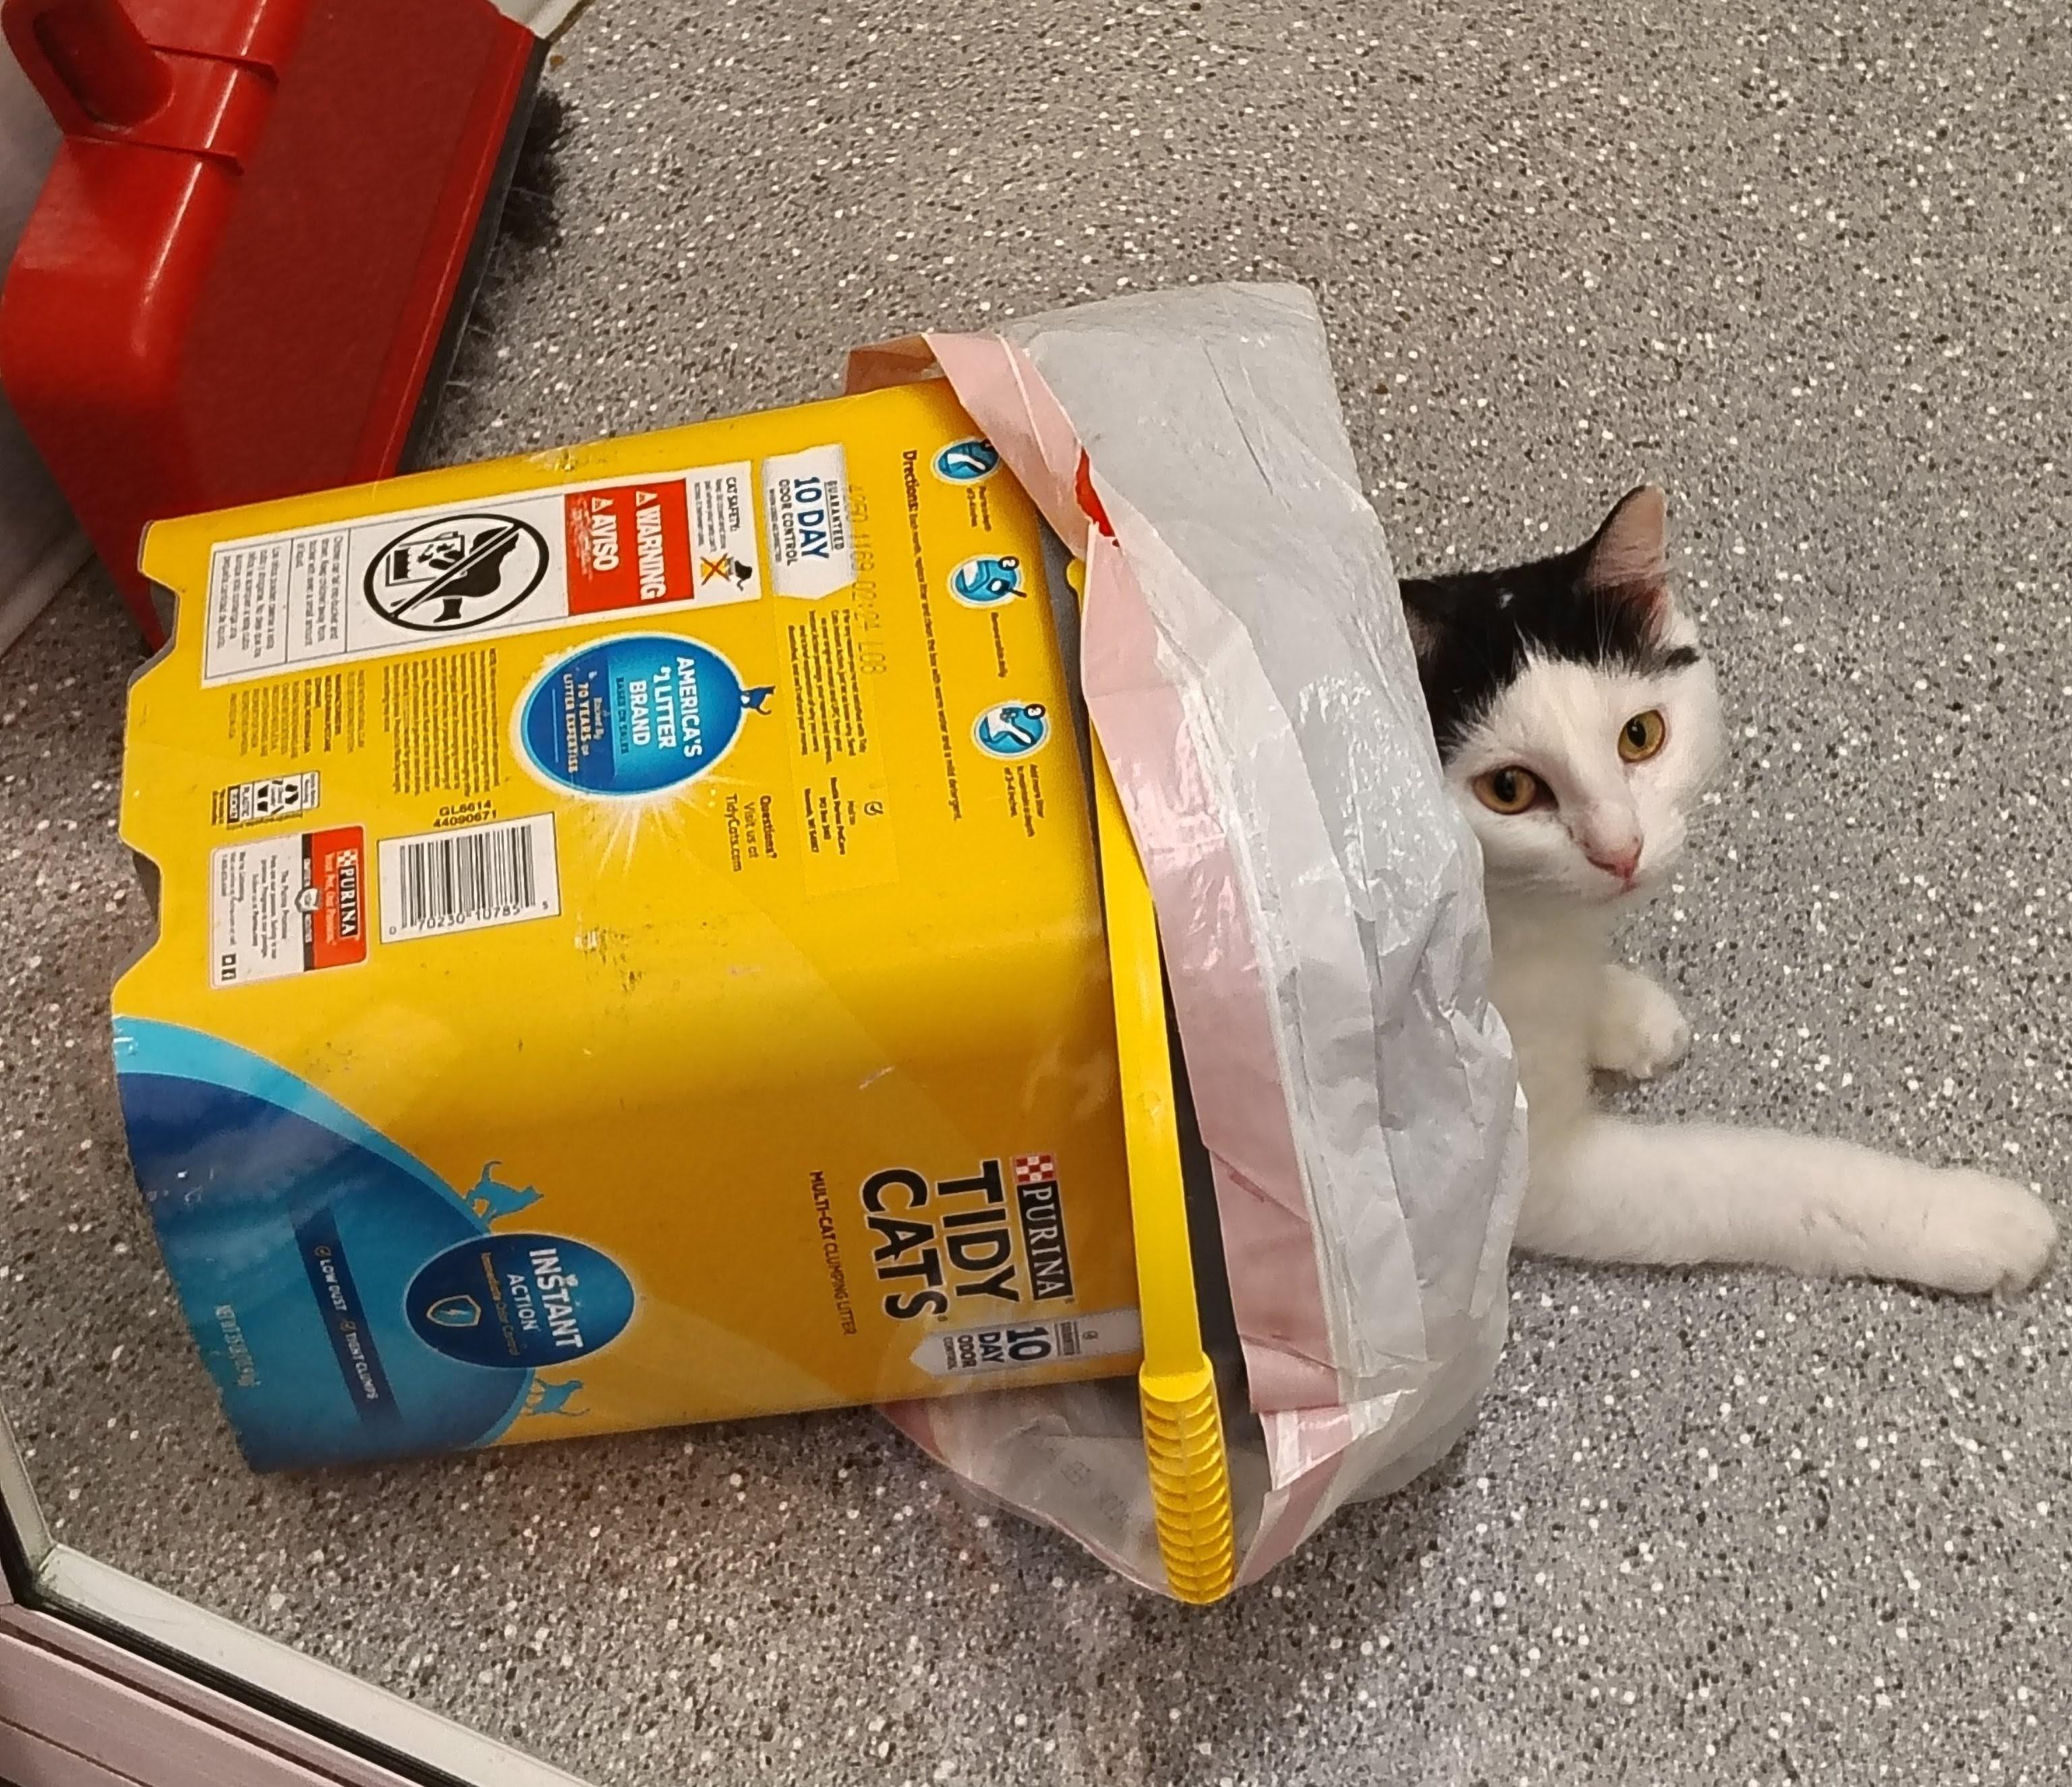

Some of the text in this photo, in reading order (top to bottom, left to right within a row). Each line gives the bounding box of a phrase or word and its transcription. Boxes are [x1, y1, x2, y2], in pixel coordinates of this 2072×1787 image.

[725, 476, 737, 493] CAT
[827, 480, 844, 550] GUARANTEED
[589, 513, 619, 571] AVISO
[778, 478, 798, 566] ODOR CONTROL
[793, 476, 829, 561] 10 DAY
[634, 505, 666, 600] WARNING
[1001, 559, 1016, 568] 2
[577, 682, 589, 698] 70
[578, 701, 592, 742] YEARS
[628, 680, 650, 745] BRAND
[654, 685, 677, 749] LITTER
[676, 656, 702, 757] AMERICA'S
[1027, 707, 1041, 717] 3
[563, 673, 579, 773] LITTER EXPERTISE
[722, 793, 743, 872] TidyCats.com
[743, 801, 758, 858] Visit us at
[759, 795, 777, 859] Questions?
[338, 867, 357, 934] PURINA
[388, 926, 397, 935] 0
[418, 915, 465, 932] 70230
[809, 1171, 856, 1335] MULTI-CAT CLUMPING LITTER
[861, 1168, 948, 1319] CATS
[937, 1160, 1019, 1302] TIDY
[1021, 1186, 1064, 1297] PURINA
[320, 1259, 347, 1311] LOW DUST
[506, 1274, 538, 1330] ACTION
[529, 1248, 583, 1347] INSTANT
[942, 1336, 956, 1369] CONTROL
[957, 1335, 975, 1367] ODOR
[979, 1332, 1004, 1363] DAY
[1006, 1327, 1051, 1360] 10
[355, 1362, 378, 1398] CLUMPS
